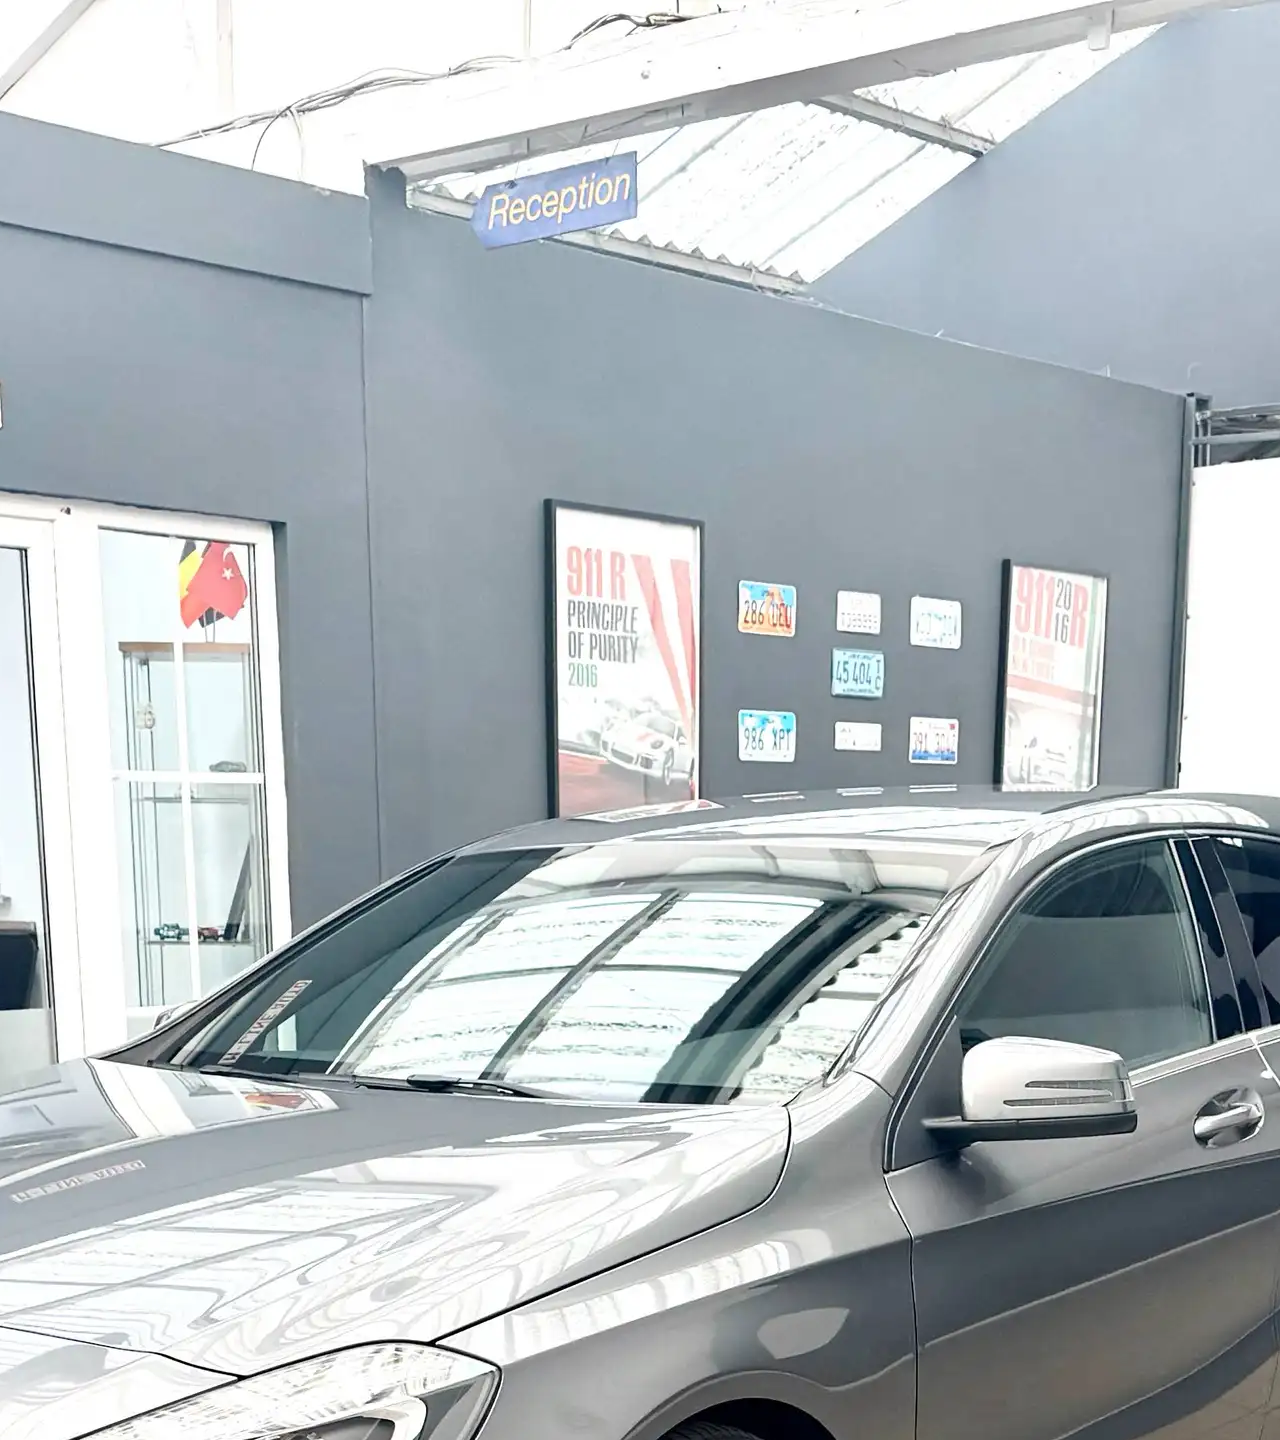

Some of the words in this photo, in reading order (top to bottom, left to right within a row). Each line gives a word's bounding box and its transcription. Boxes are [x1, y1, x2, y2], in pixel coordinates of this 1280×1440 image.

[488, 172, 631, 231] Reception
[566, 545, 603, 599] 911
[609, 550, 626, 601] R
[567, 599, 639, 635] PRINCIPLE
[1014, 566, 1056, 640] 911
[1068, 582, 1089, 649] R
[568, 630, 585, 659] OF
[589, 634, 639, 664] PURITY
[568, 662, 599, 688] 2016
